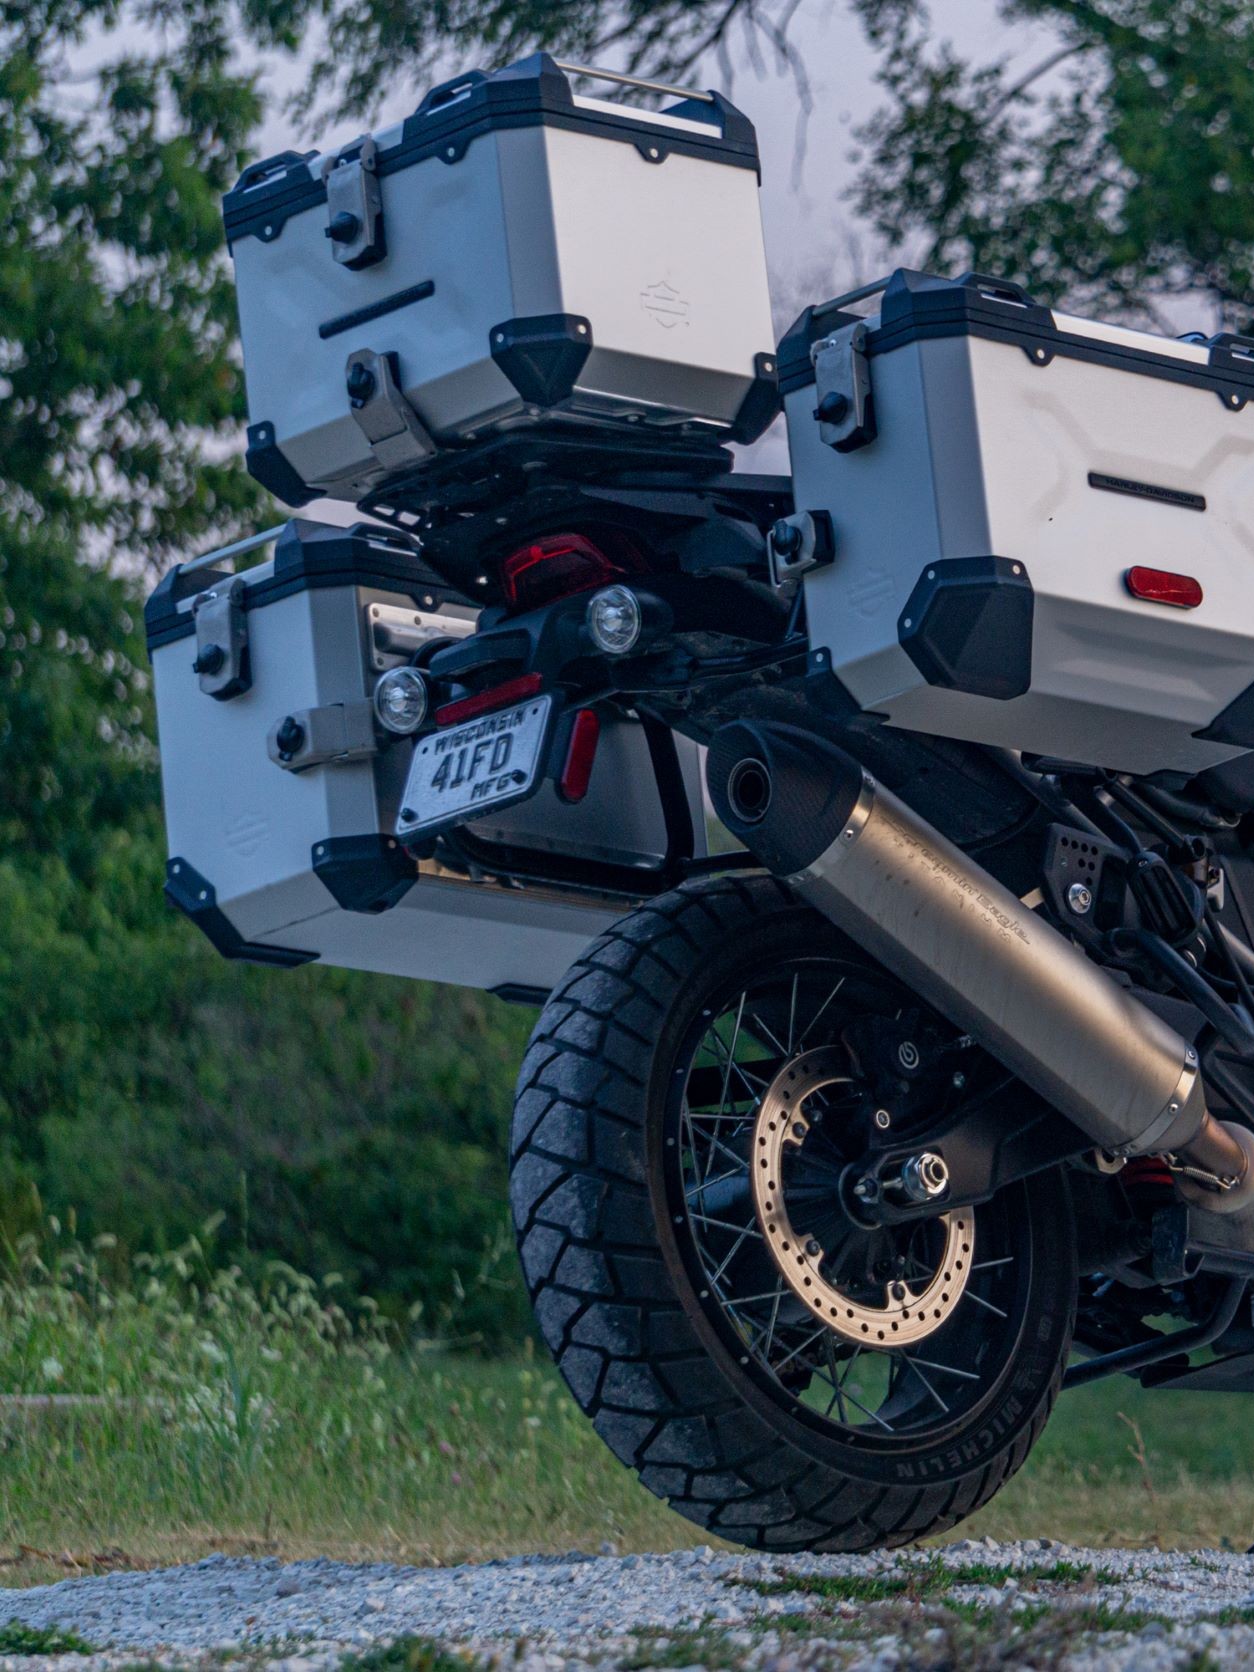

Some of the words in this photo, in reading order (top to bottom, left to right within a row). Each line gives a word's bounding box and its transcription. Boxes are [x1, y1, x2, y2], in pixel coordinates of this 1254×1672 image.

[434, 708, 527, 756] WISCONSIN
[430, 732, 514, 794] 41FD
[471, 773, 510, 801] MFG
[896, 1394, 1024, 1478] MICHELIN
